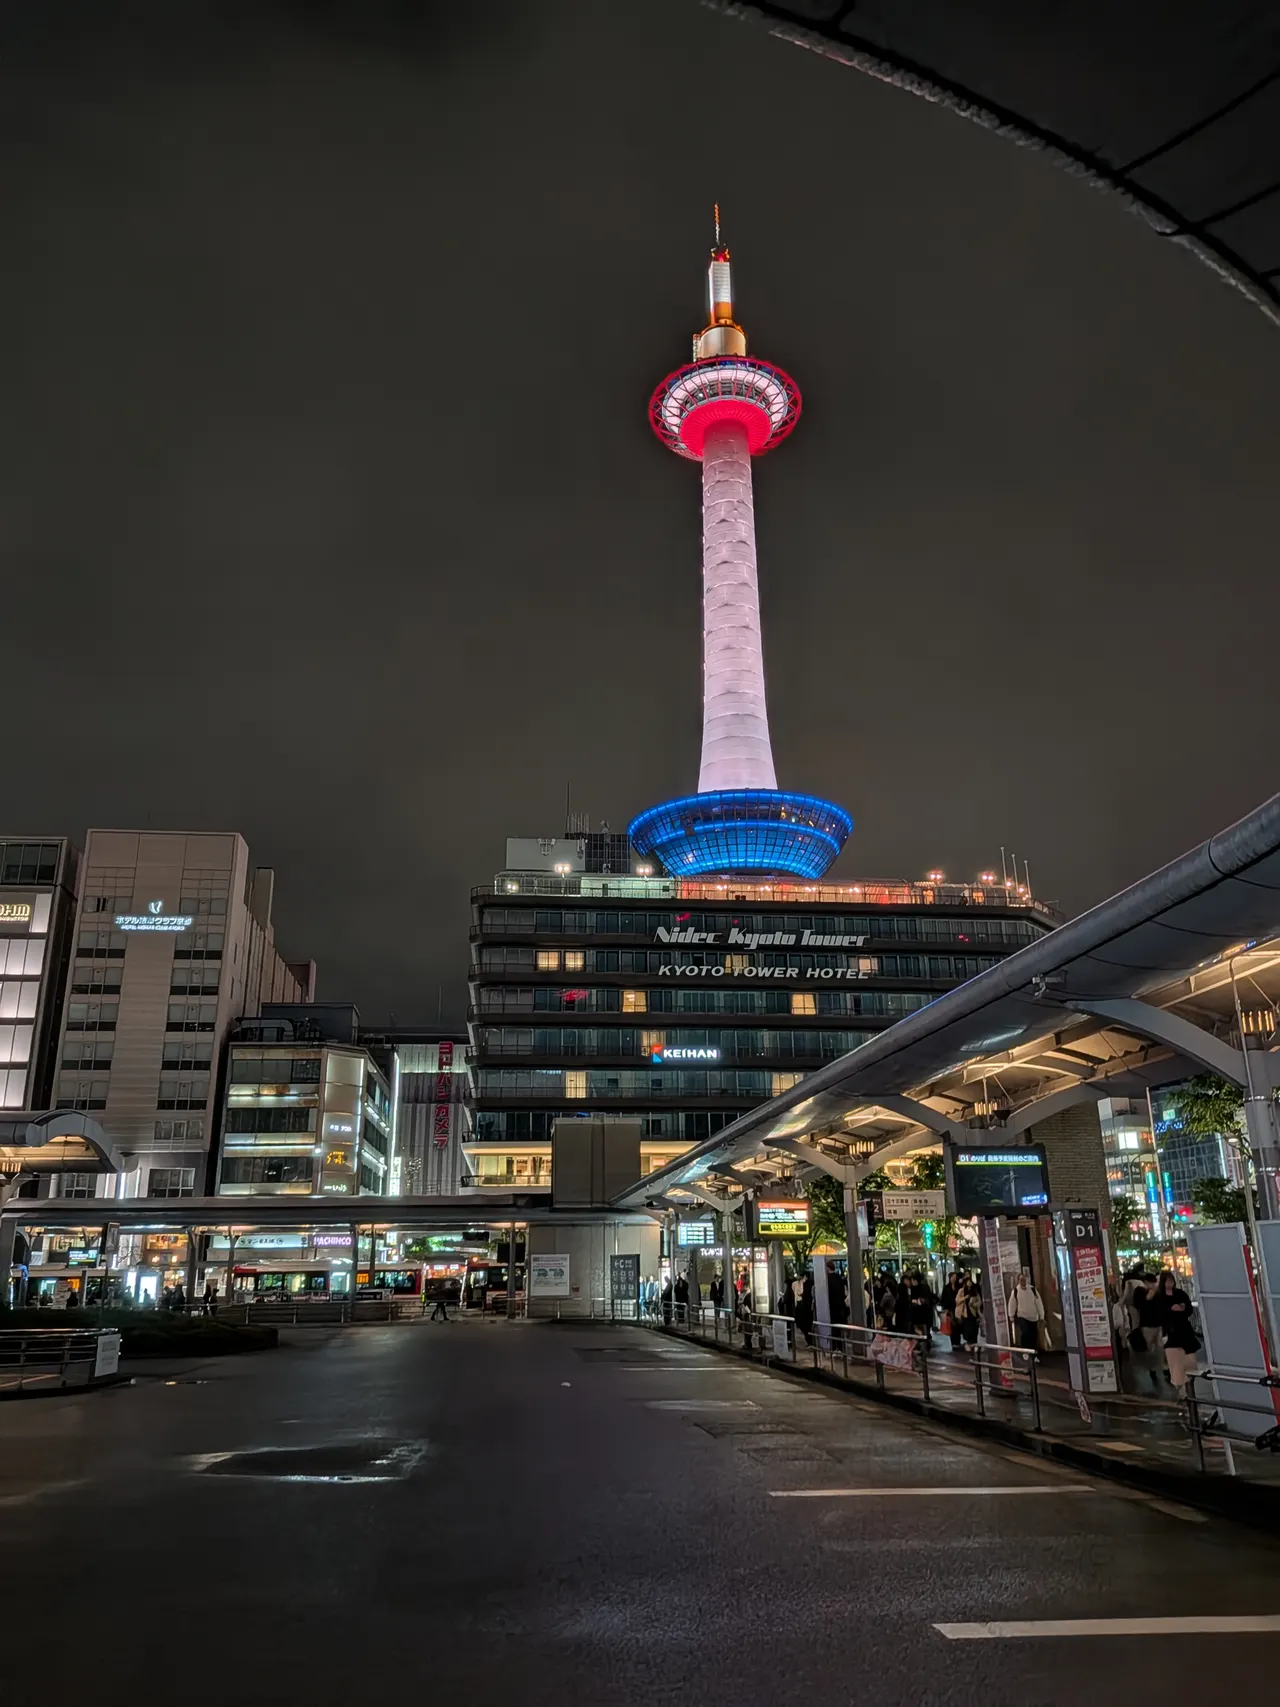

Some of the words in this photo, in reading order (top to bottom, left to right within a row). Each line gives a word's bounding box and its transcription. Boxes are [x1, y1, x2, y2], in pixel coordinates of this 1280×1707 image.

[654, 926, 722, 944] Nidec
[728, 927, 797, 950] Kyoto
[801, 929, 870, 947] Tower
[658, 965, 724, 977] KYOTO
[732, 966, 799, 978] TOWER
[806, 967, 869, 979] HOTEL
[664, 1048, 717, 1059] KEIHAN
[433, 1041, 454, 1149] ヨドバシカメラ
[1075, 1224, 1094, 1238] D1
[619, 1259, 625, 1269] C
